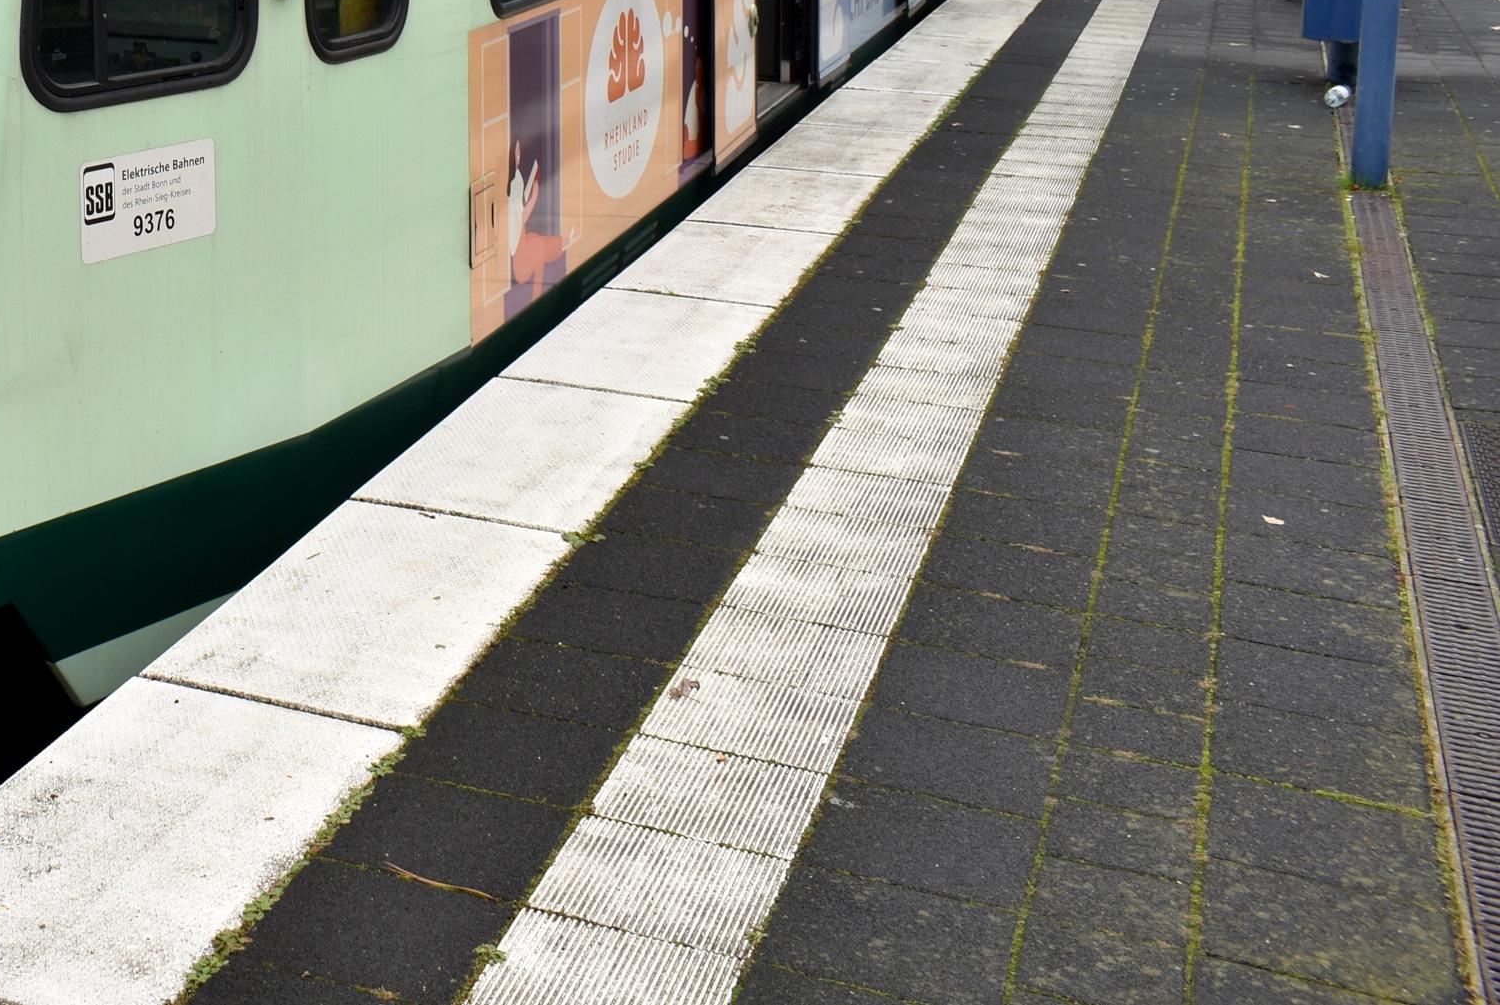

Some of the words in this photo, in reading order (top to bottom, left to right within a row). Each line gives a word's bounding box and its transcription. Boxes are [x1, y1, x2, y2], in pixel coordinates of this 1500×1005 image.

[604, 109, 648, 150] RHEINLAND
[122, 161, 170, 181] Elektrische
[172, 156, 204, 170] Bahnen
[613, 139, 639, 171] STUDIE
[85, 182, 113, 216] SSB
[122, 187, 132, 195] der
[134, 182, 150, 193] Stadt
[152, 179, 167, 189] Bonn
[169, 176, 181, 185] und
[122, 200, 133, 209] des
[135, 188, 191, 207] Rhein-Sieg-Kreises
[133, 208, 175, 236] 9376
